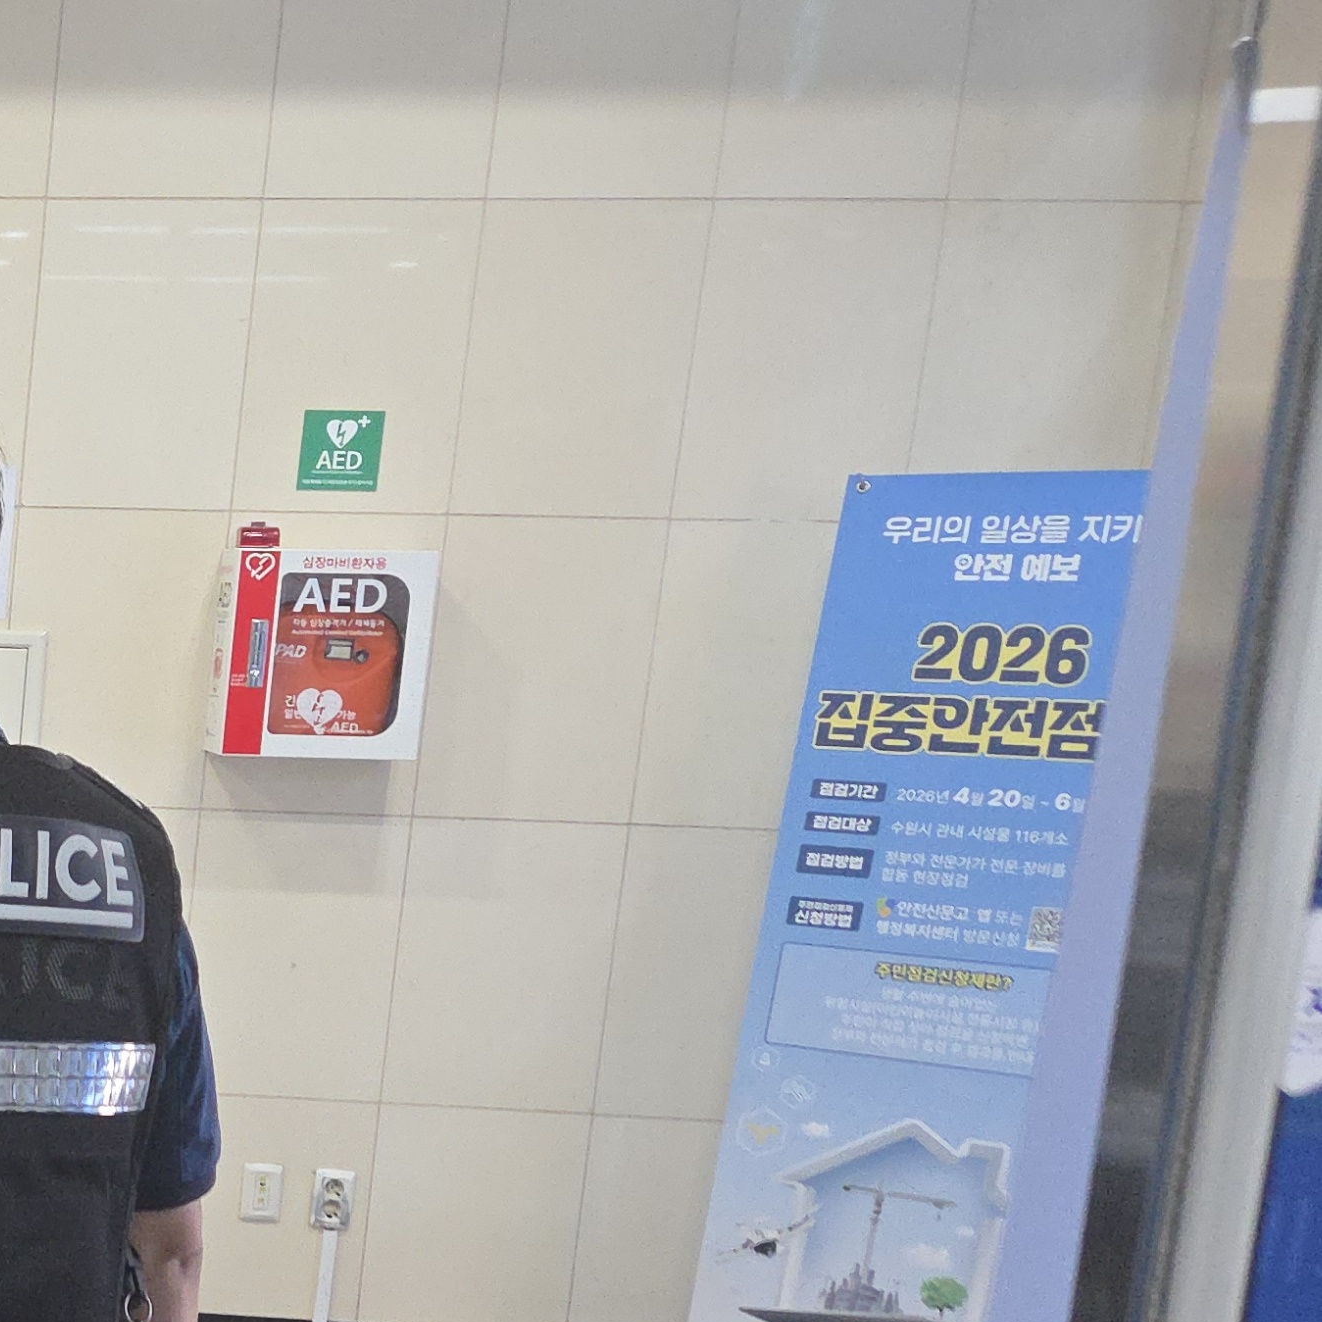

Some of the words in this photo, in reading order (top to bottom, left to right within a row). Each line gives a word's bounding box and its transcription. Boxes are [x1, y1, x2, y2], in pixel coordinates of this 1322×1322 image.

[315, 449, 363, 471] AED
[882, 515, 972, 545] 우리의
[980, 514, 1071, 545] 일상을
[1078, 513, 1146, 545] 지키
[953, 553, 1013, 583] 안전
[1020, 553, 1082, 583] 예보
[292, 577, 389, 614] AED
[912, 624, 1092, 685] 2026
[331, 722, 360, 734] AED
[811, 690, 1109, 760] 집중안전점
[819, 782, 879, 800] 점검기간
[896, 788, 950, 805] 2026년
[812, 815, 873, 832] 점검대상
[805, 852, 864, 870] 점검방법
